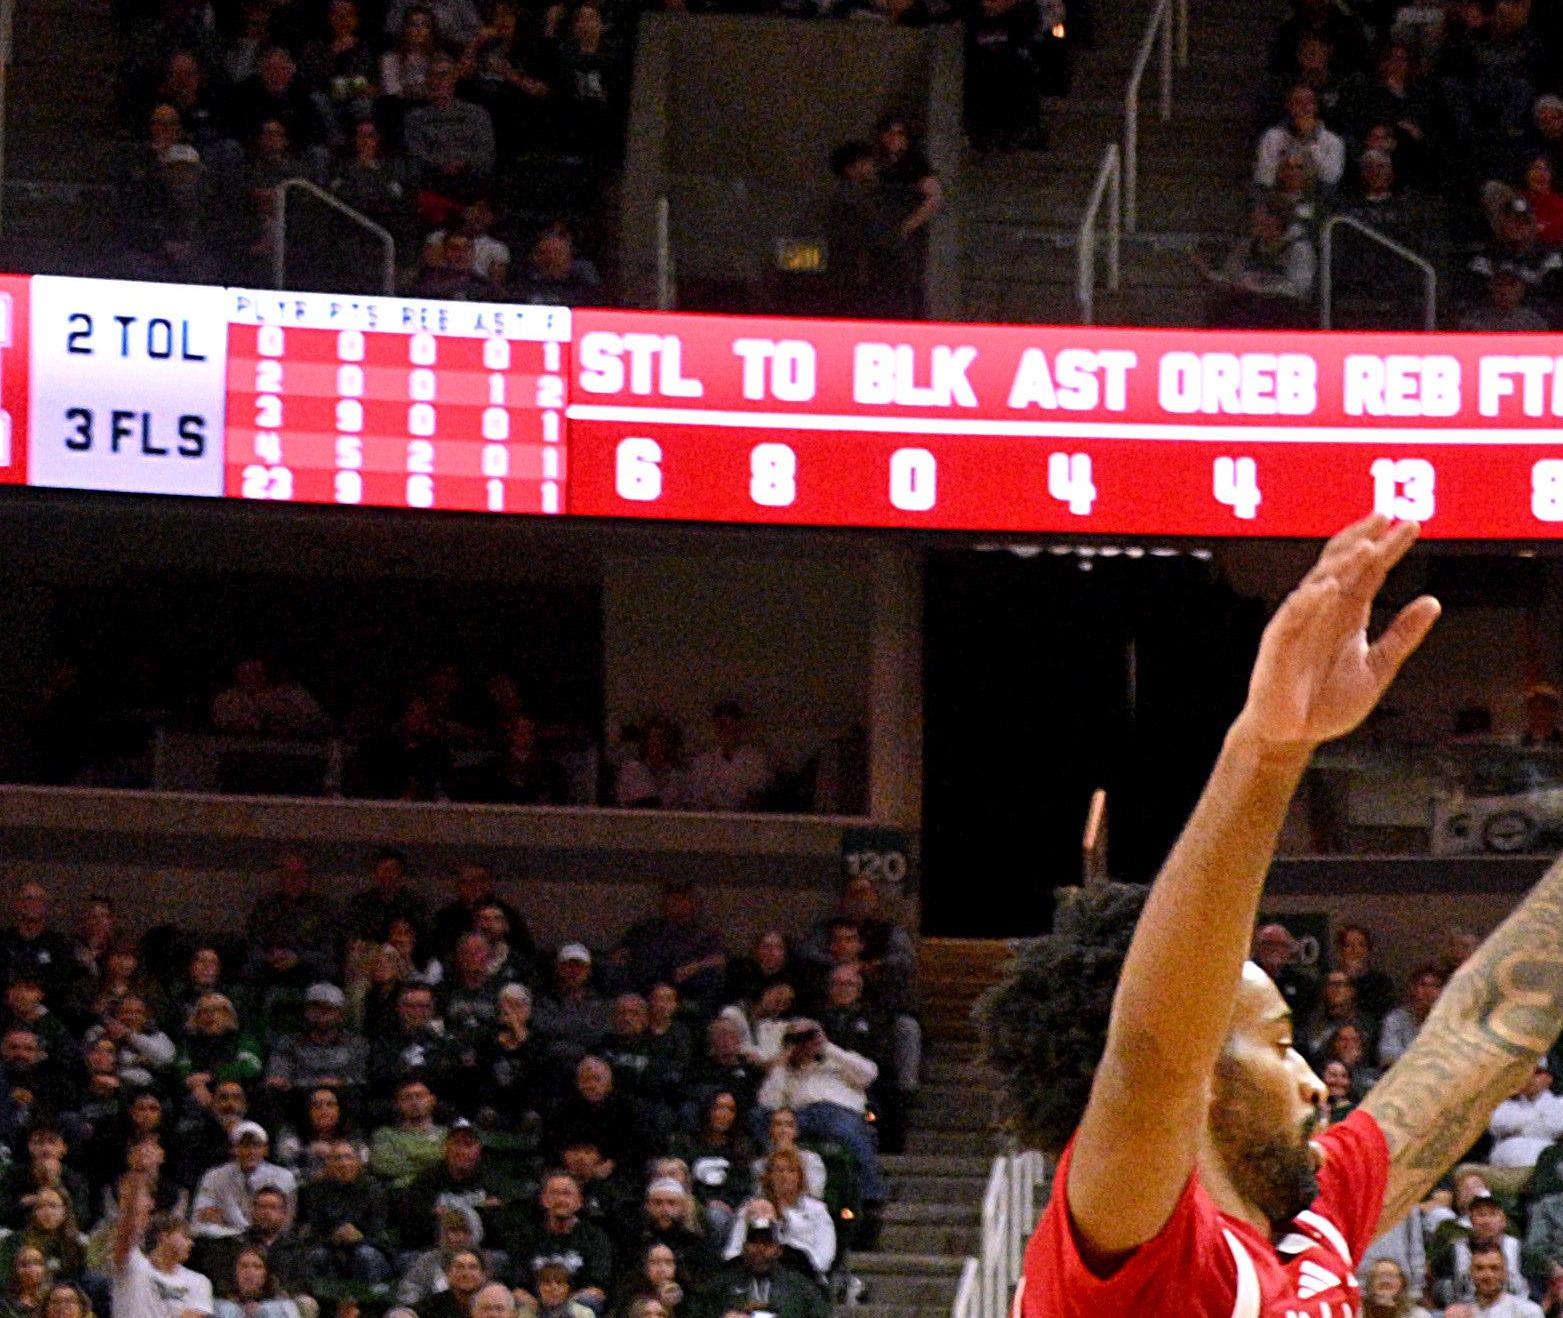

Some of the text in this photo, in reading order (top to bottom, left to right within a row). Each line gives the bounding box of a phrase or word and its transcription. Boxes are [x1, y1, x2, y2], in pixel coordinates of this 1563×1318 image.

[67, 313, 208, 362] 2 TOL
[257, 325, 285, 357] 0
[337, 329, 365, 361] 0
[409, 333, 437, 365] 0
[544, 341, 561, 372] 1
[256, 359, 283, 393] 2
[488, 372, 505, 405] 1
[536, 374, 563, 408] 2
[580, 331, 702, 397] STL
[732, 338, 817, 401] TO
[854, 342, 977, 407] BLK
[1008, 347, 1136, 411] AST
[1159, 352, 1317, 415] OREB
[1344, 354, 1461, 417] REB
[65, 407, 93, 451] 3
[111, 410, 206, 458] FLS
[541, 410, 559, 442] 1
[407, 439, 434, 473] 2
[542, 446, 558, 479] 1
[615, 437, 662, 500] 6
[750, 443, 796, 506] 8
[889, 448, 937, 511] 0
[1048, 452, 1096, 515] 4
[1213, 456, 1261, 519] 4
[1371, 458, 1435, 523] 13
[487, 478, 504, 512] 1
[541, 480, 559, 514] 1
